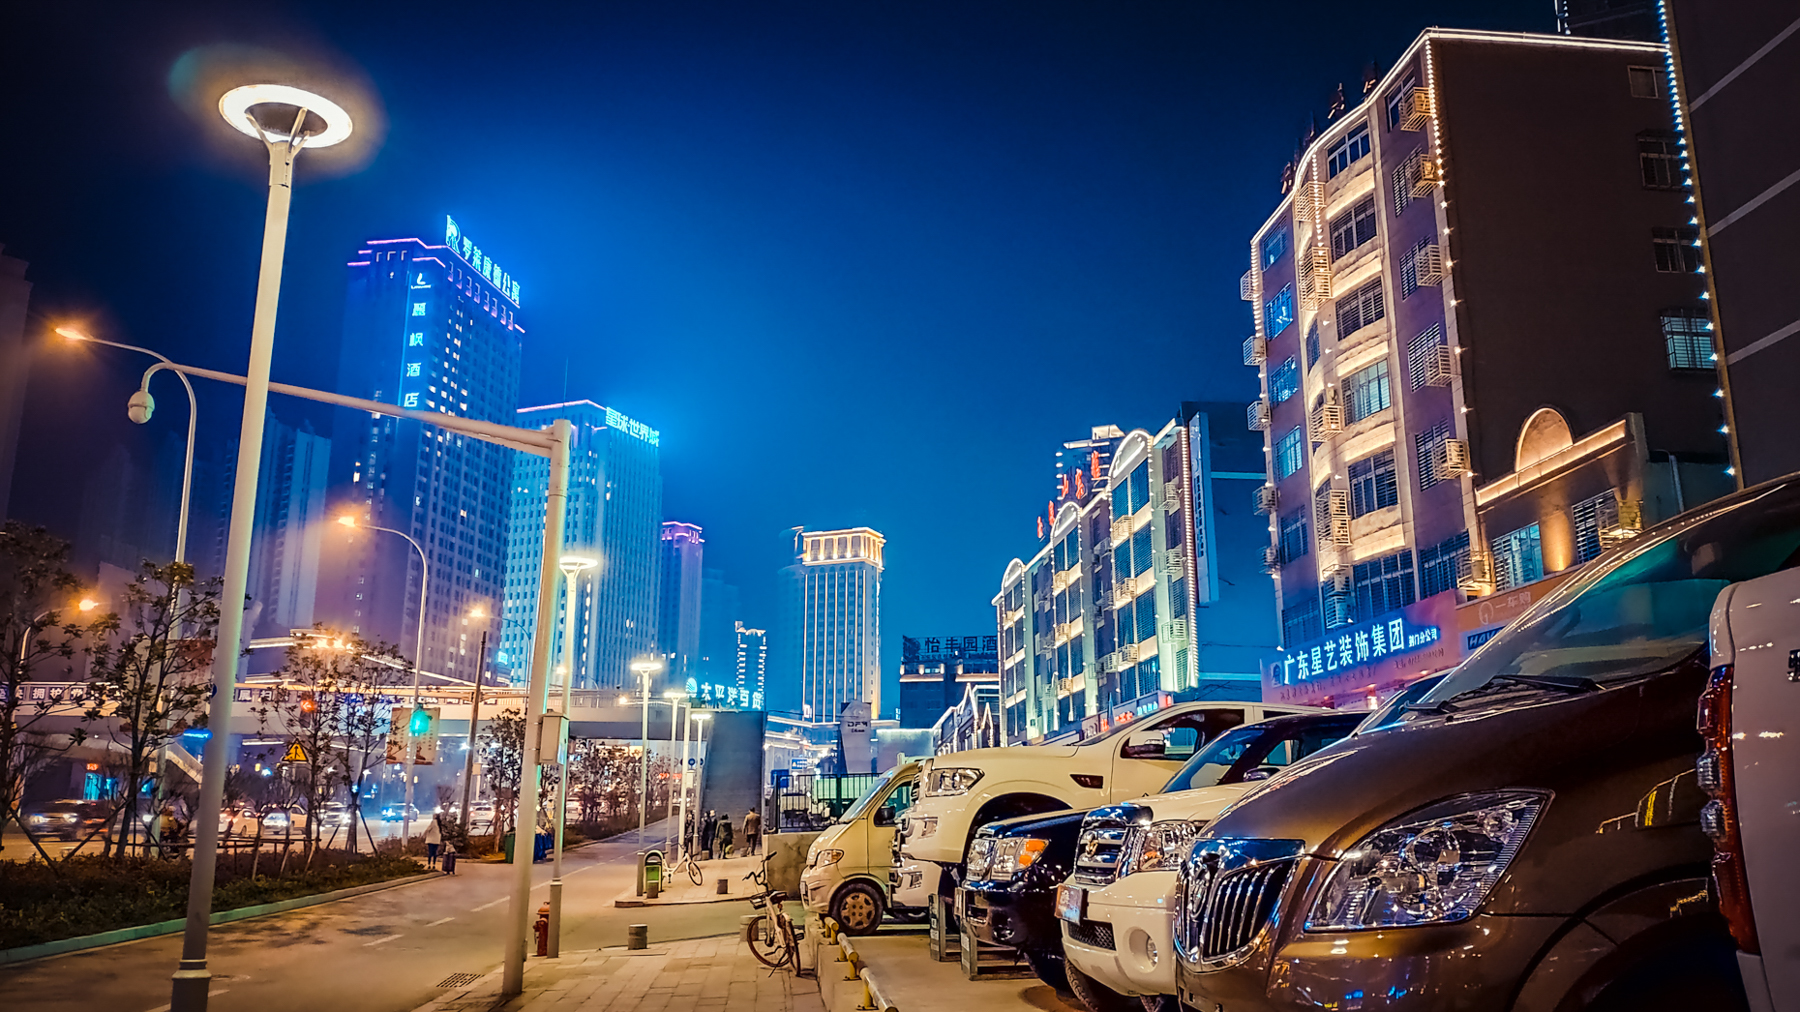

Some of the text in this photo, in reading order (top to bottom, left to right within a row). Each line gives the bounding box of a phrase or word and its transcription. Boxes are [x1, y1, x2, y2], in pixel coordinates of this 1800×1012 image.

[925, 635, 997, 653] 怡丰园酒
[1284, 618, 1405, 685] 广东星艺装饰集团
[700, 682, 763, 711] 太平洋百货
